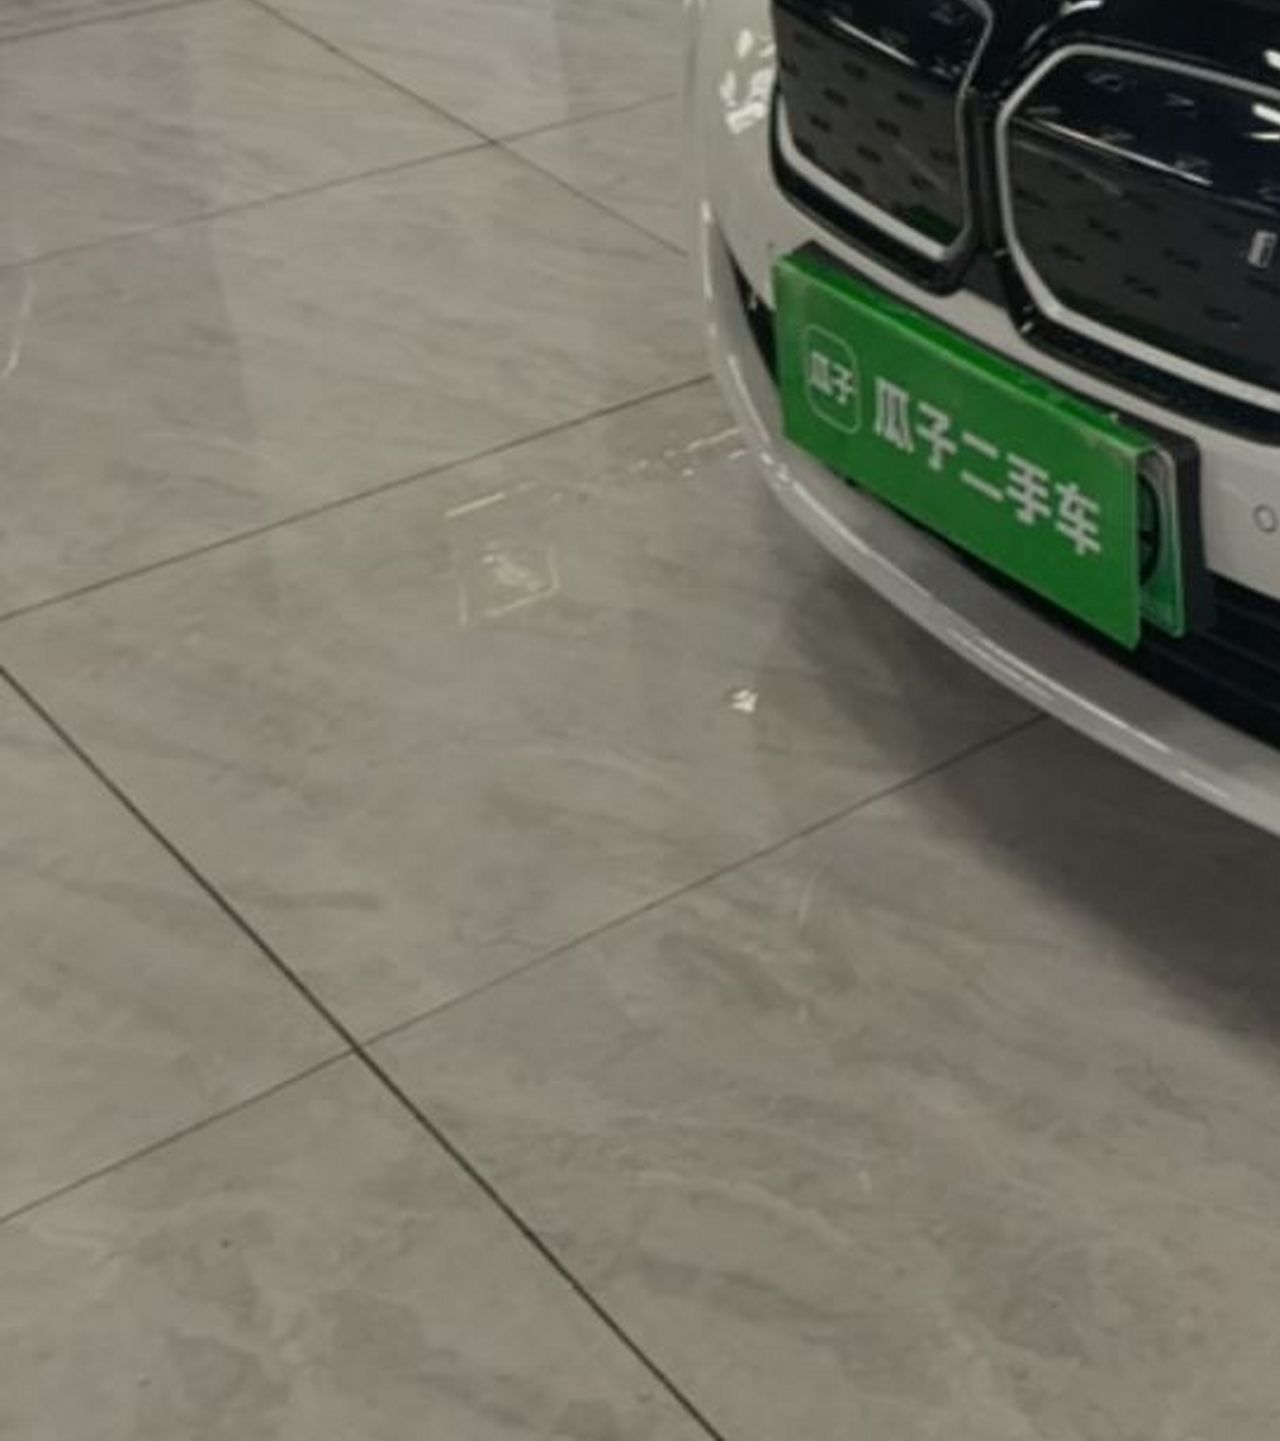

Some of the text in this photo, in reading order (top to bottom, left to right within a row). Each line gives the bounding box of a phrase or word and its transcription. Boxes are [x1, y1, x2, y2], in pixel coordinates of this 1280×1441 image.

[874, 376, 1101, 556] 瓜子二手车
